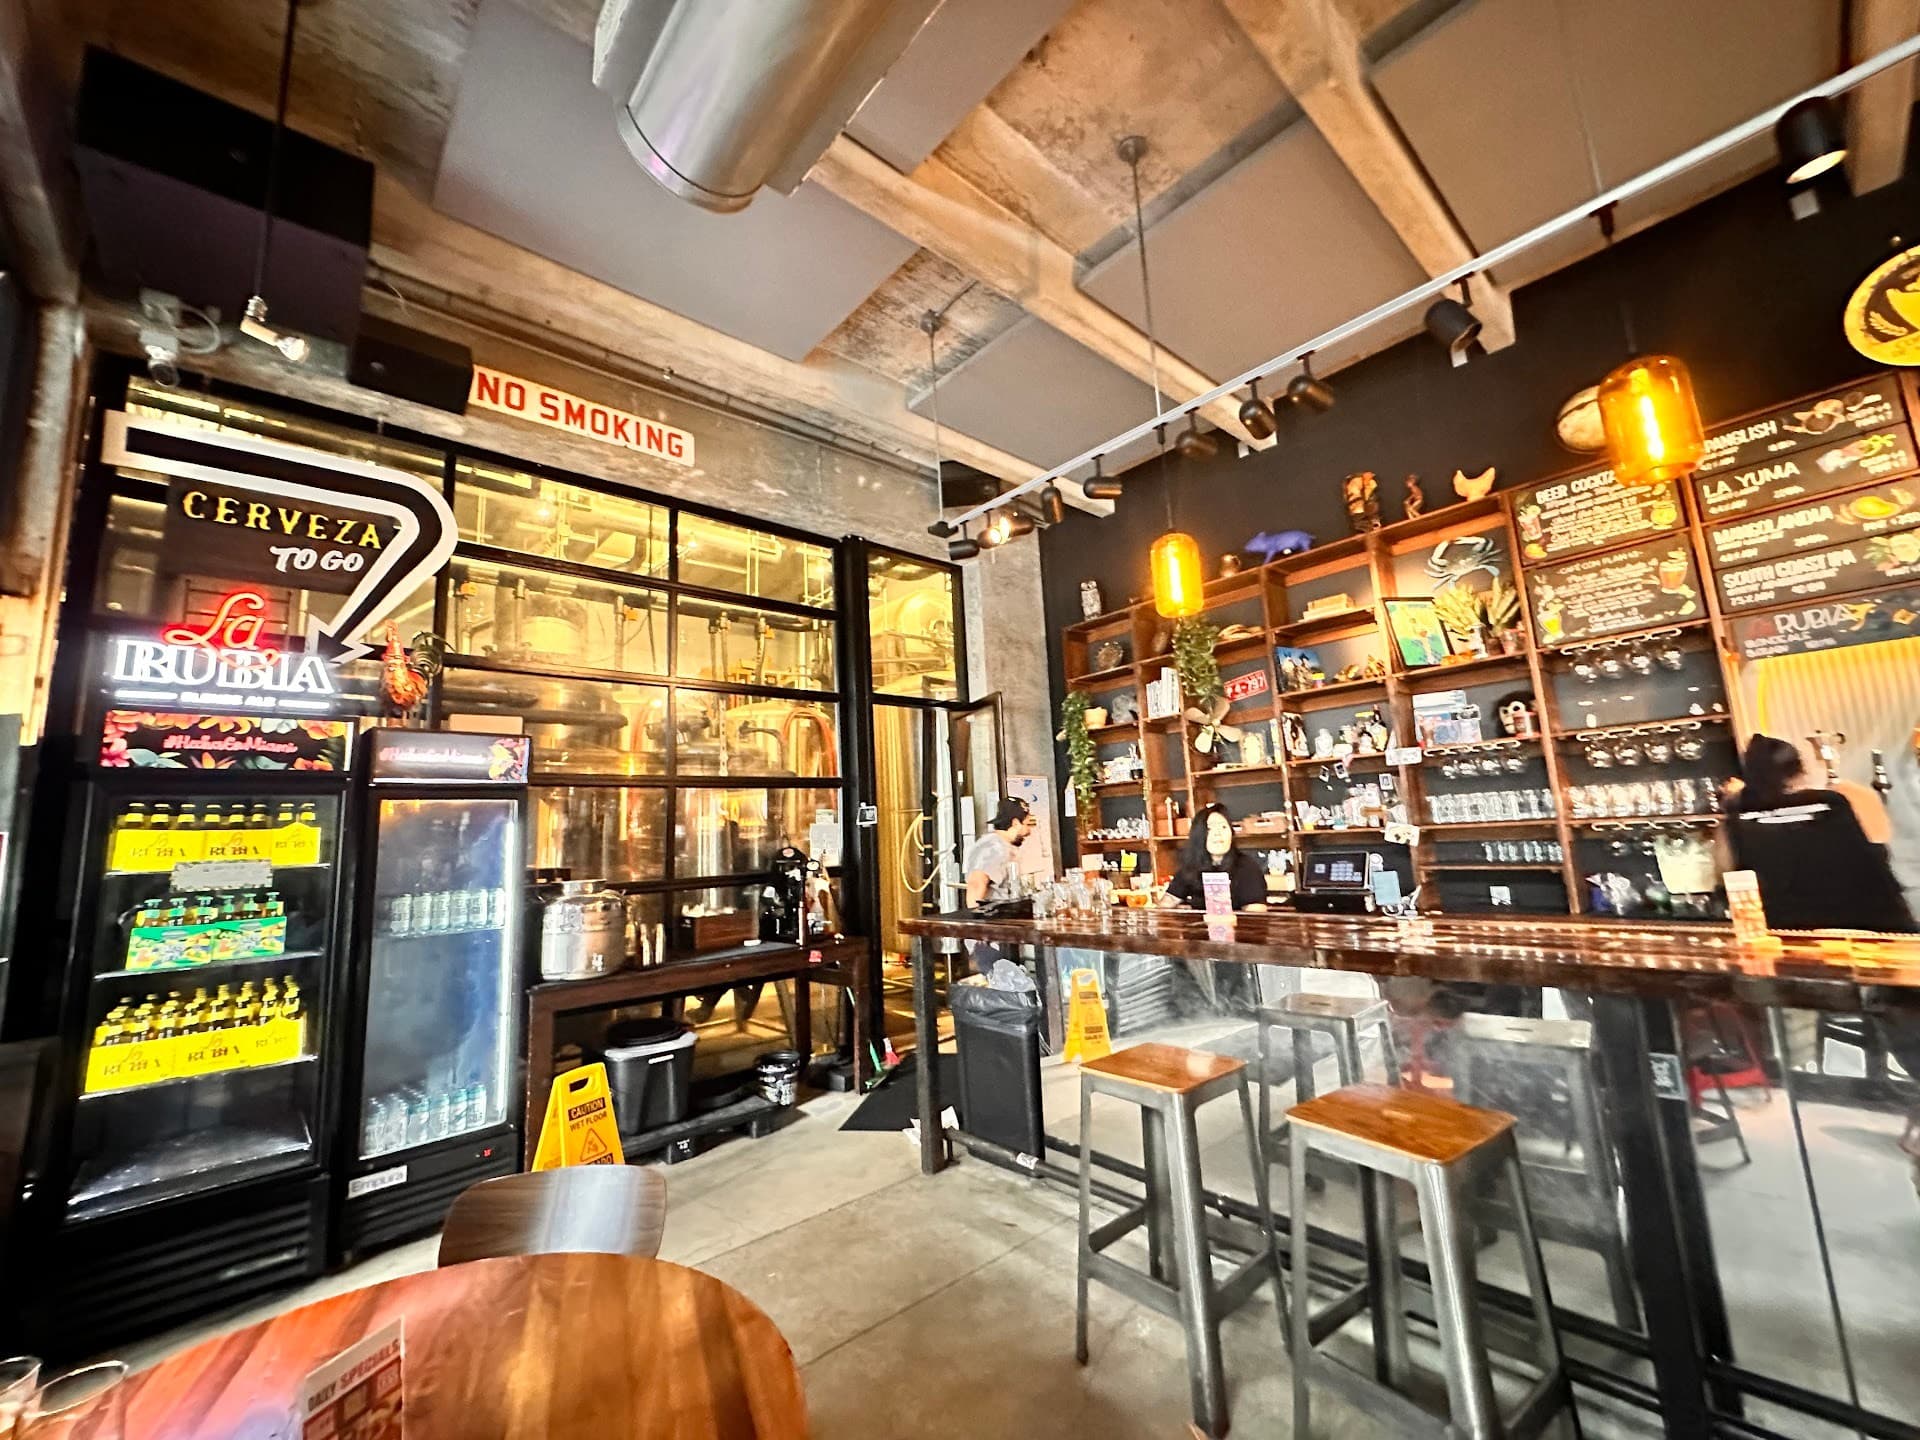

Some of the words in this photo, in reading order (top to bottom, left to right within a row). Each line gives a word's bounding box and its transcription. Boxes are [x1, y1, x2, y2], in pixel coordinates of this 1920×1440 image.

[477, 372, 526, 411] NO
[540, 392, 684, 458] SMOKING
[1704, 420, 1778, 453] PANGLISH
[1536, 484, 1568, 504] BEER
[1703, 481, 1732, 499] LA
[1735, 461, 1801, 488] YUMA
[183, 491, 382, 549] CERVEZA
[269, 546, 318, 573] TO
[319, 550, 364, 572] GO
[1722, 565, 1775, 589] SOUTH
[1775, 555, 1827, 579] COAST
[1827, 549, 1857, 568] IPA
[164, 592, 282, 671] La
[1773, 603, 1858, 634] RUBIA
[112, 639, 335, 695] RUBIA
[569, 1098, 605, 1120] CAUTION
[569, 1120, 585, 1132] WET
[585, 1111, 607, 1126] FLOOR
